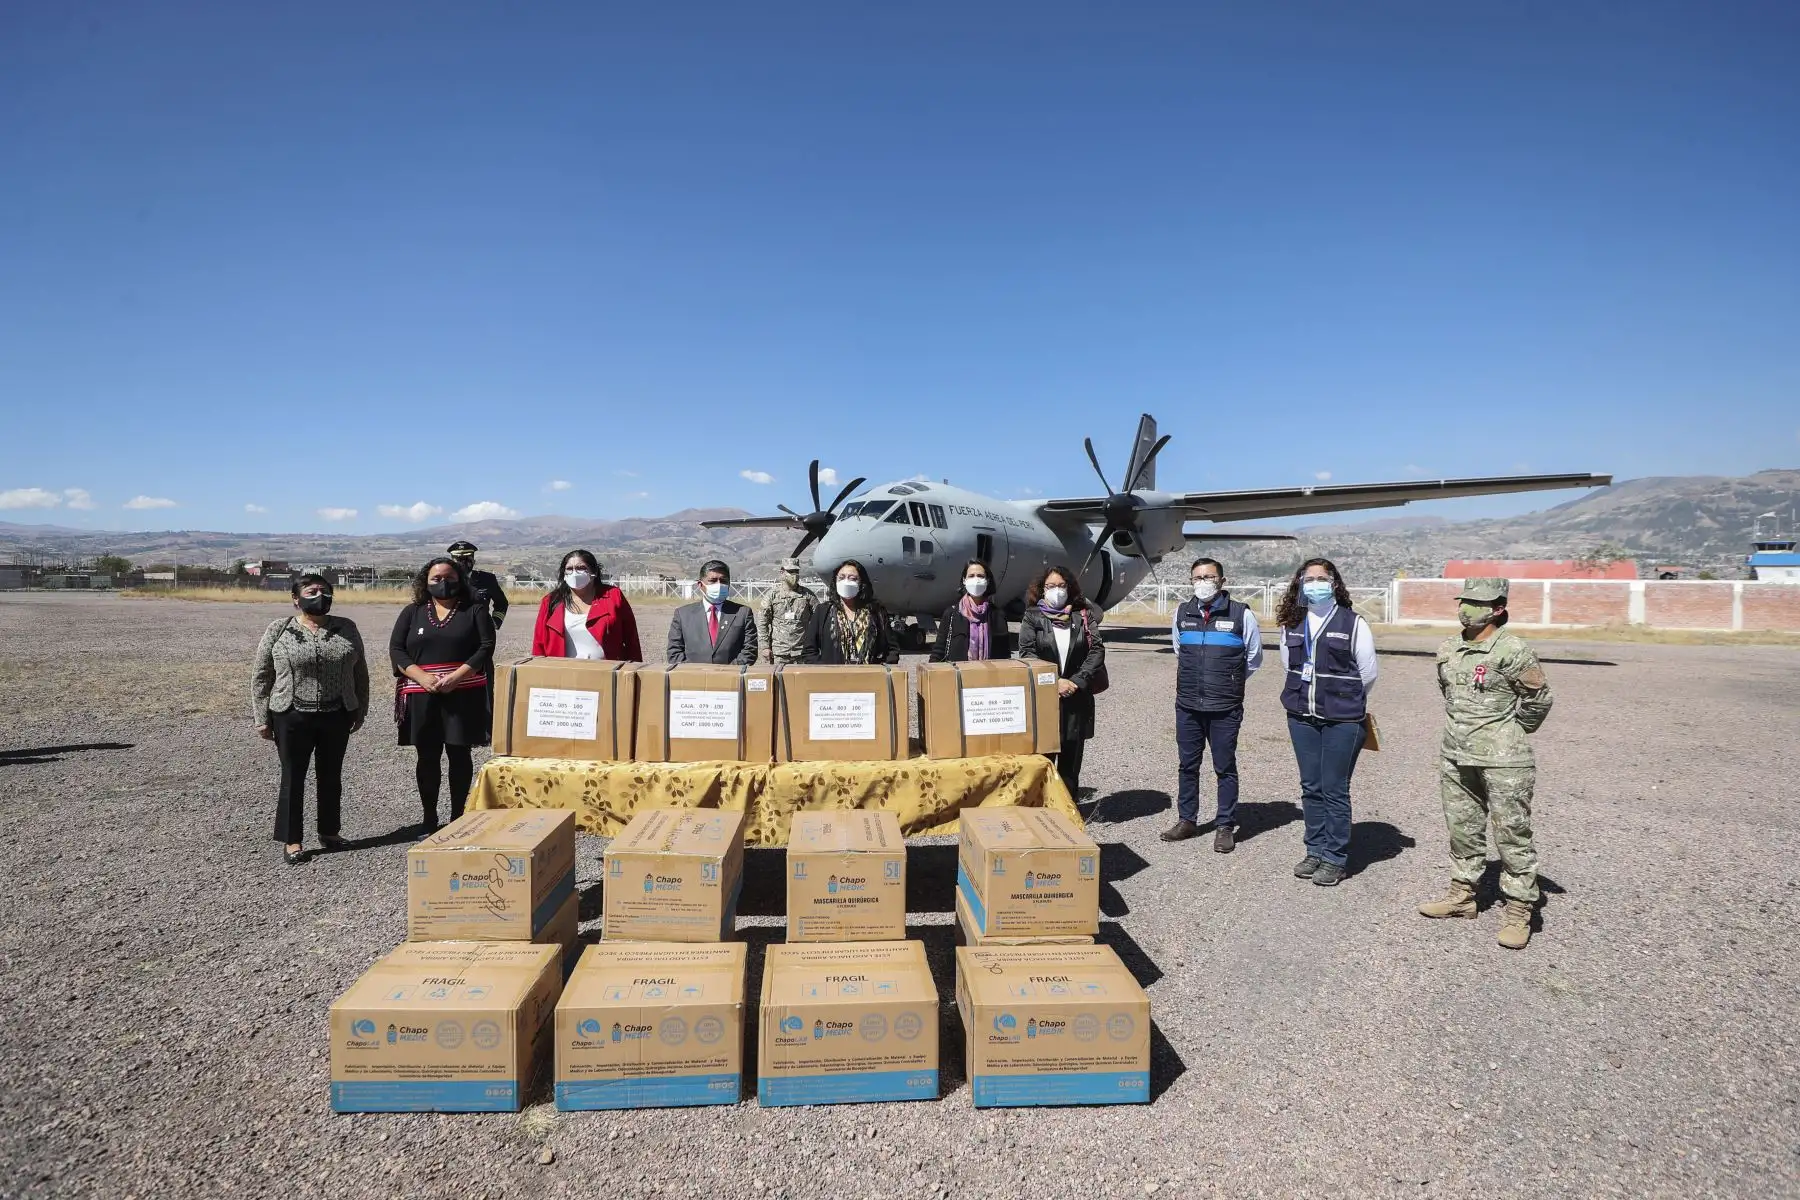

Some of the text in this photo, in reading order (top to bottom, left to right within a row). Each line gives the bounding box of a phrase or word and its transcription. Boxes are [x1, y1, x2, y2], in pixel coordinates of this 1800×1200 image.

[948, 504, 982, 517] FUERZA
[462, 873, 489, 882] Chapo
[655, 876, 683, 885] Chapo
[839, 876, 866, 885] Chapo
[1036, 872, 1062, 881] Chapo
[422, 977, 467, 986] FRAGIL
[825, 975, 869, 983] FRAGIL
[1029, 975, 1072, 983] FRAGIL
[825, 1021, 853, 1029] Chapo
[1039, 1020, 1066, 1028] Chapo
[399, 1026, 429, 1035] Chapo
[624, 1025, 653, 1033] Chapo
